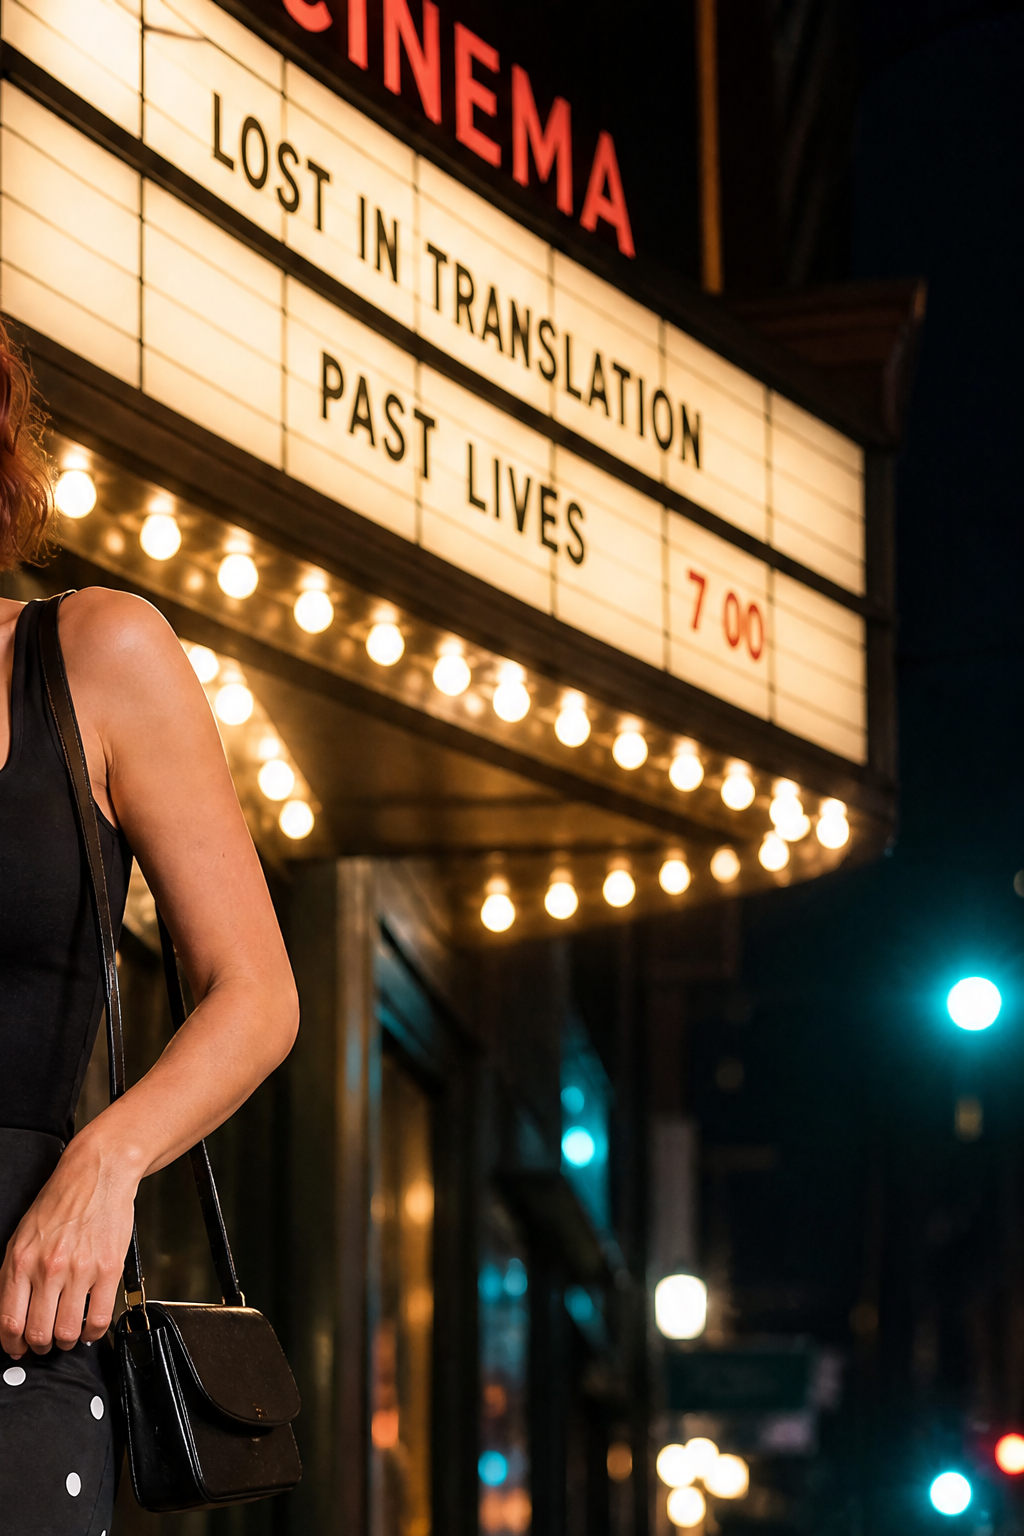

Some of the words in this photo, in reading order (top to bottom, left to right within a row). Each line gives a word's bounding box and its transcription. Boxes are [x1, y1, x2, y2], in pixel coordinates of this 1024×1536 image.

[282, 0, 636, 258] INEMA
[212, 92, 331, 232] LOST
[359, 195, 399, 284] IN
[426, 242, 701, 470] TRANSLATION
[321, 351, 436, 480] PAST
[467, 442, 586, 566] LIVES
